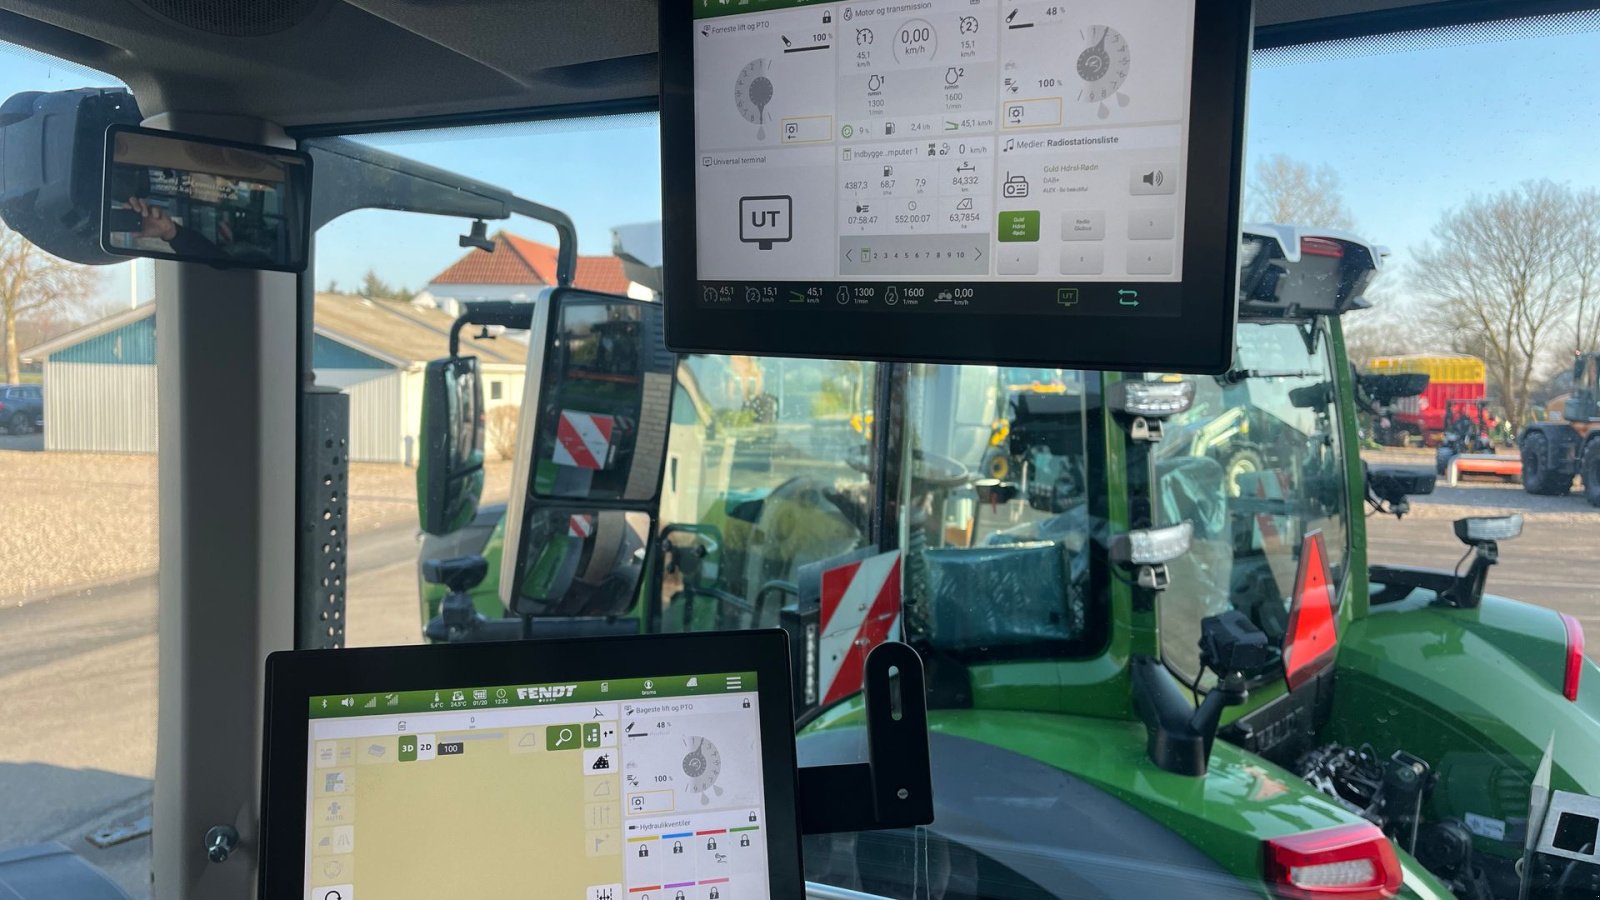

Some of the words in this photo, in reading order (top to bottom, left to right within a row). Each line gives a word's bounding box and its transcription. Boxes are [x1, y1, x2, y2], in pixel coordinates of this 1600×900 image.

[855, 8, 874, 17] Motor
[886, 2, 932, 13] transmission
[1046, 8, 1057, 16] 48
[712, 26, 737, 34] Forreste
[813, 34, 826, 42] 100
[901, 28, 930, 44] 0,00
[961, 41, 975, 49] 15,1
[905, 46, 925, 54] km/h
[857, 52, 870, 60] 45,1
[959, 68, 964, 77] 2
[1038, 79, 1054, 87] 100
[1016, 140, 1045, 149] Medier:
[1047, 136, 1119, 147] Radiostationsliste
[959, 144, 965, 154] 0
[952, 177, 978, 185] 84,332
[752, 211, 780, 227] UT
[950, 213, 980, 222] 63,7854
[720, 287, 734, 295] 45,1
[763, 287, 777, 295] 15,1
[807, 288, 823, 296] 45,1
[854, 288, 874, 297] 1300
[888, 294, 895, 302] 2
[903, 288, 925, 298] 1600
[954, 288, 973, 299] 0,00
[516, 685, 577, 699] FENDT
[636, 705, 660, 714] Bageste
[640, 820, 690, 830] Hydraulikventiler
